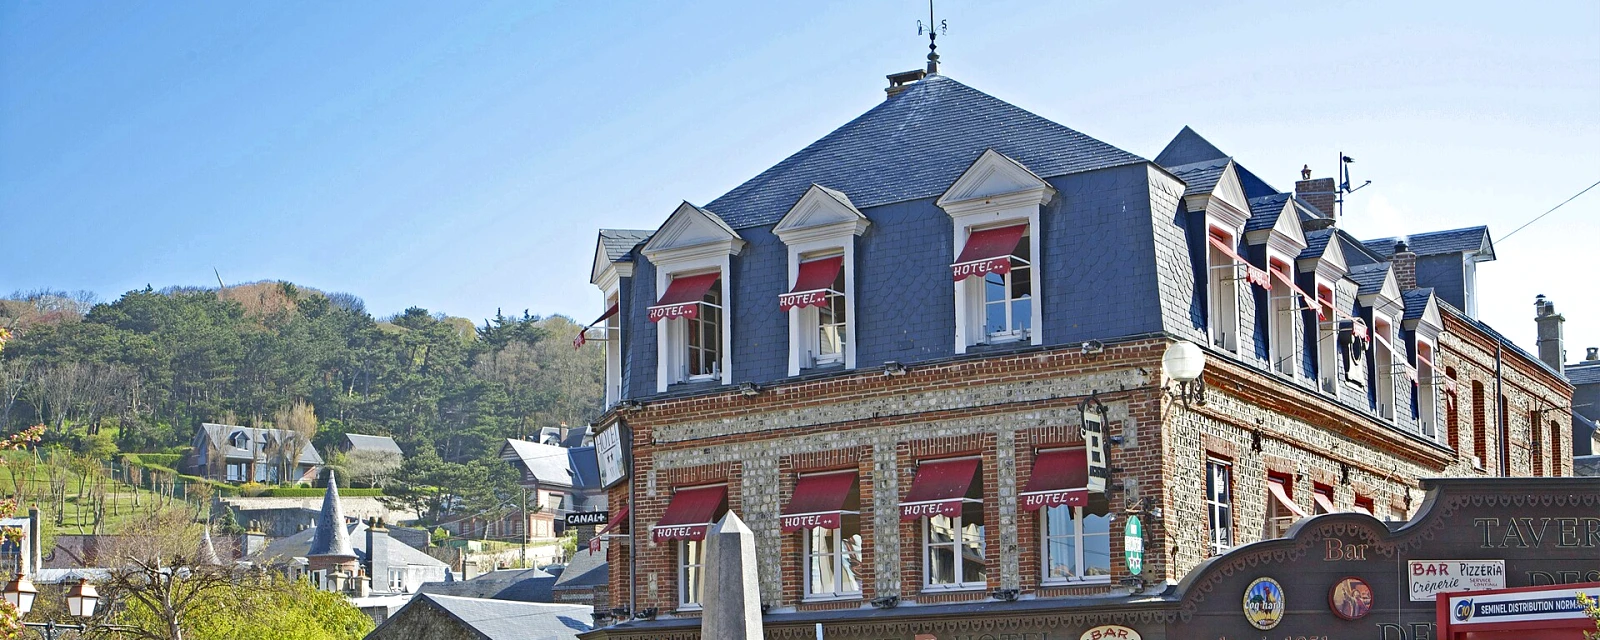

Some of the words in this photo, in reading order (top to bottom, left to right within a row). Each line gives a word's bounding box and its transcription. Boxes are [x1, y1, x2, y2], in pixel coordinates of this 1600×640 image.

[953, 261, 993, 276] HOTEL
[780, 293, 815, 306] HOTEL
[650, 305, 683, 318] HOTEL
[1026, 492, 1068, 506] HOTEL
[904, 503, 943, 516] HOTEL
[567, 513, 605, 523] CANAL+
[785, 515, 821, 527] HOTEL
[657, 526, 691, 538] HOTEL
[1323, 537, 1368, 561] Bar
[1413, 563, 1449, 576] BAR
[1481, 604, 1507, 615] SEMINEL
[1508, 600, 1554, 613] DISTRIBUTION
[1091, 628, 1129, 640] BAR
